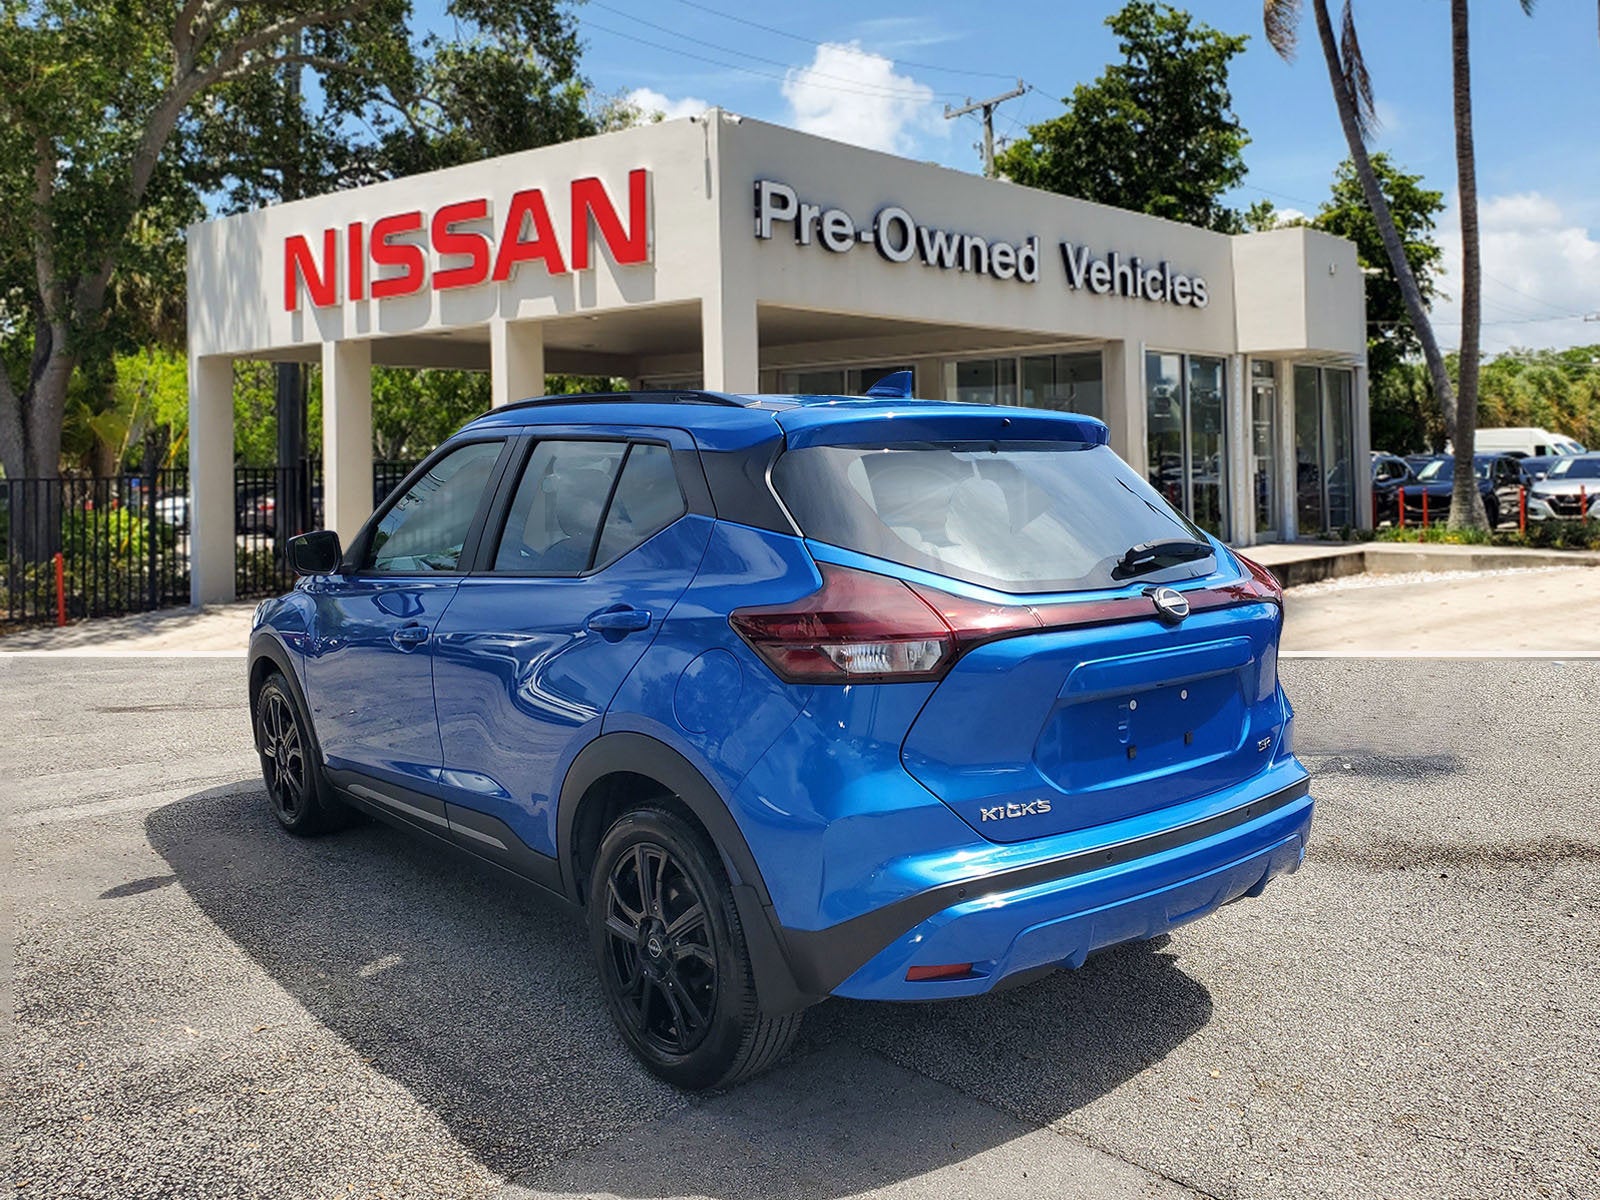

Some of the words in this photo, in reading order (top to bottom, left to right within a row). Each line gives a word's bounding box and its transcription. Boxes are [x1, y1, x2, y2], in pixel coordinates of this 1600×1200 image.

[284, 168, 654, 311] NISSAN
[754, 179, 1040, 284] Pre-Owned
[1060, 241, 1209, 309] Vehicles
[980, 799, 1052, 822] KICKS
